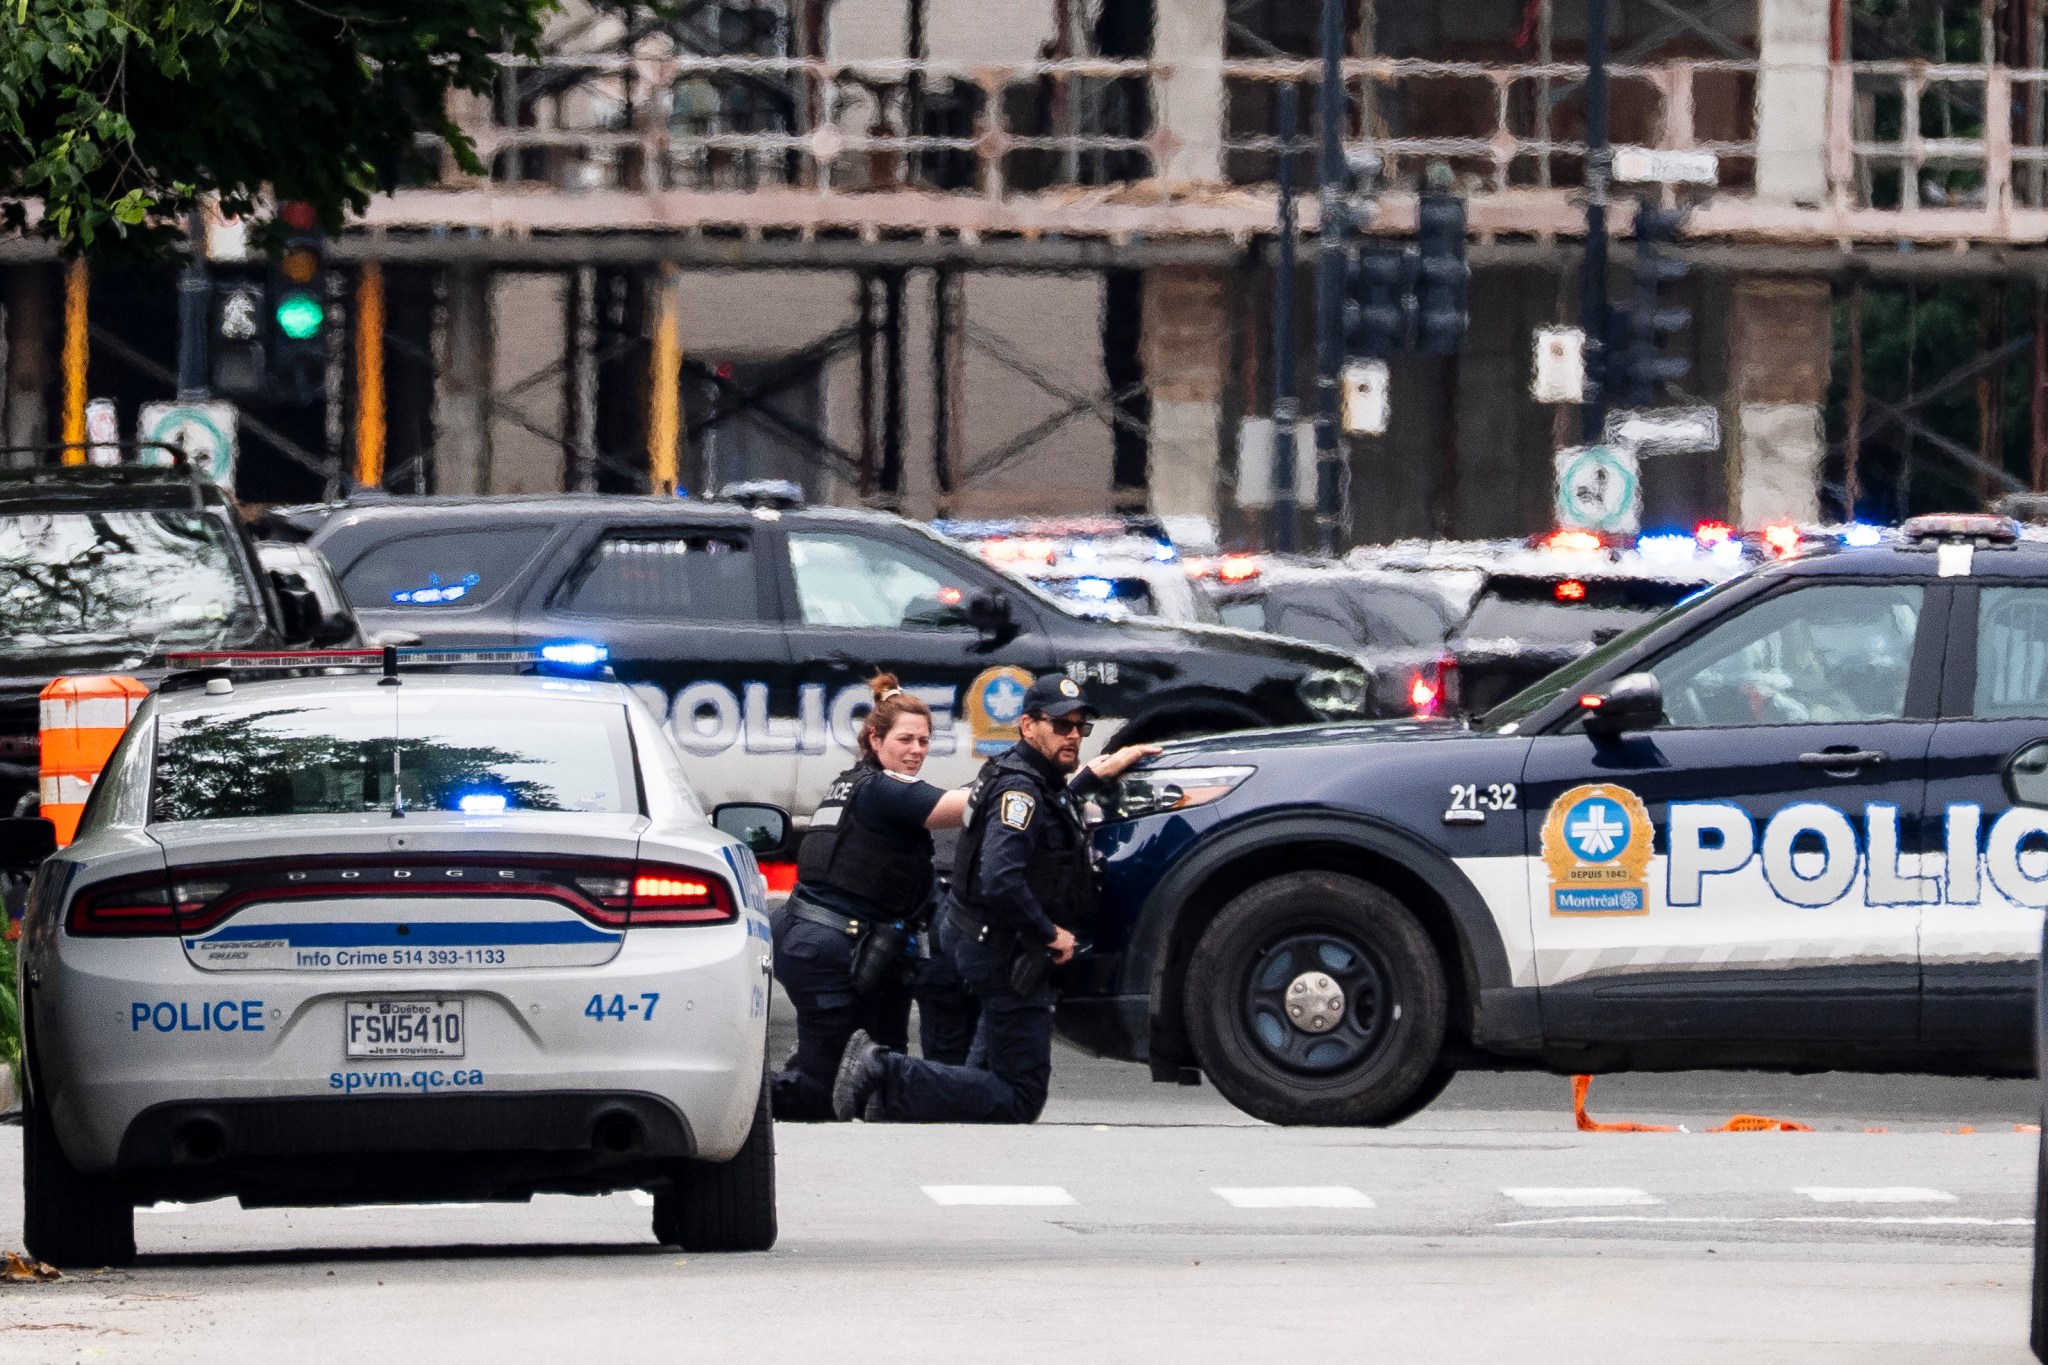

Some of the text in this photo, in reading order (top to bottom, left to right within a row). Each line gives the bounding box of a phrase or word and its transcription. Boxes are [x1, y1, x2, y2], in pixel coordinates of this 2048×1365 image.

[1450, 783, 1517, 810] 21-32
[287, 869, 515, 880] DODGE
[1570, 870, 1602, 879] DEPUIS
[1559, 893, 1619, 909] Montréal
[296, 949, 505, 966] Info Crime 514 393-1133
[131, 1000, 265, 1033] POLICE
[391, 1003, 431, 1014] Québec
[584, 992, 660, 1022] 44-7
[350, 1014, 460, 1043] FSW5410
[329, 1068, 484, 1094] spvm.qc.ca
